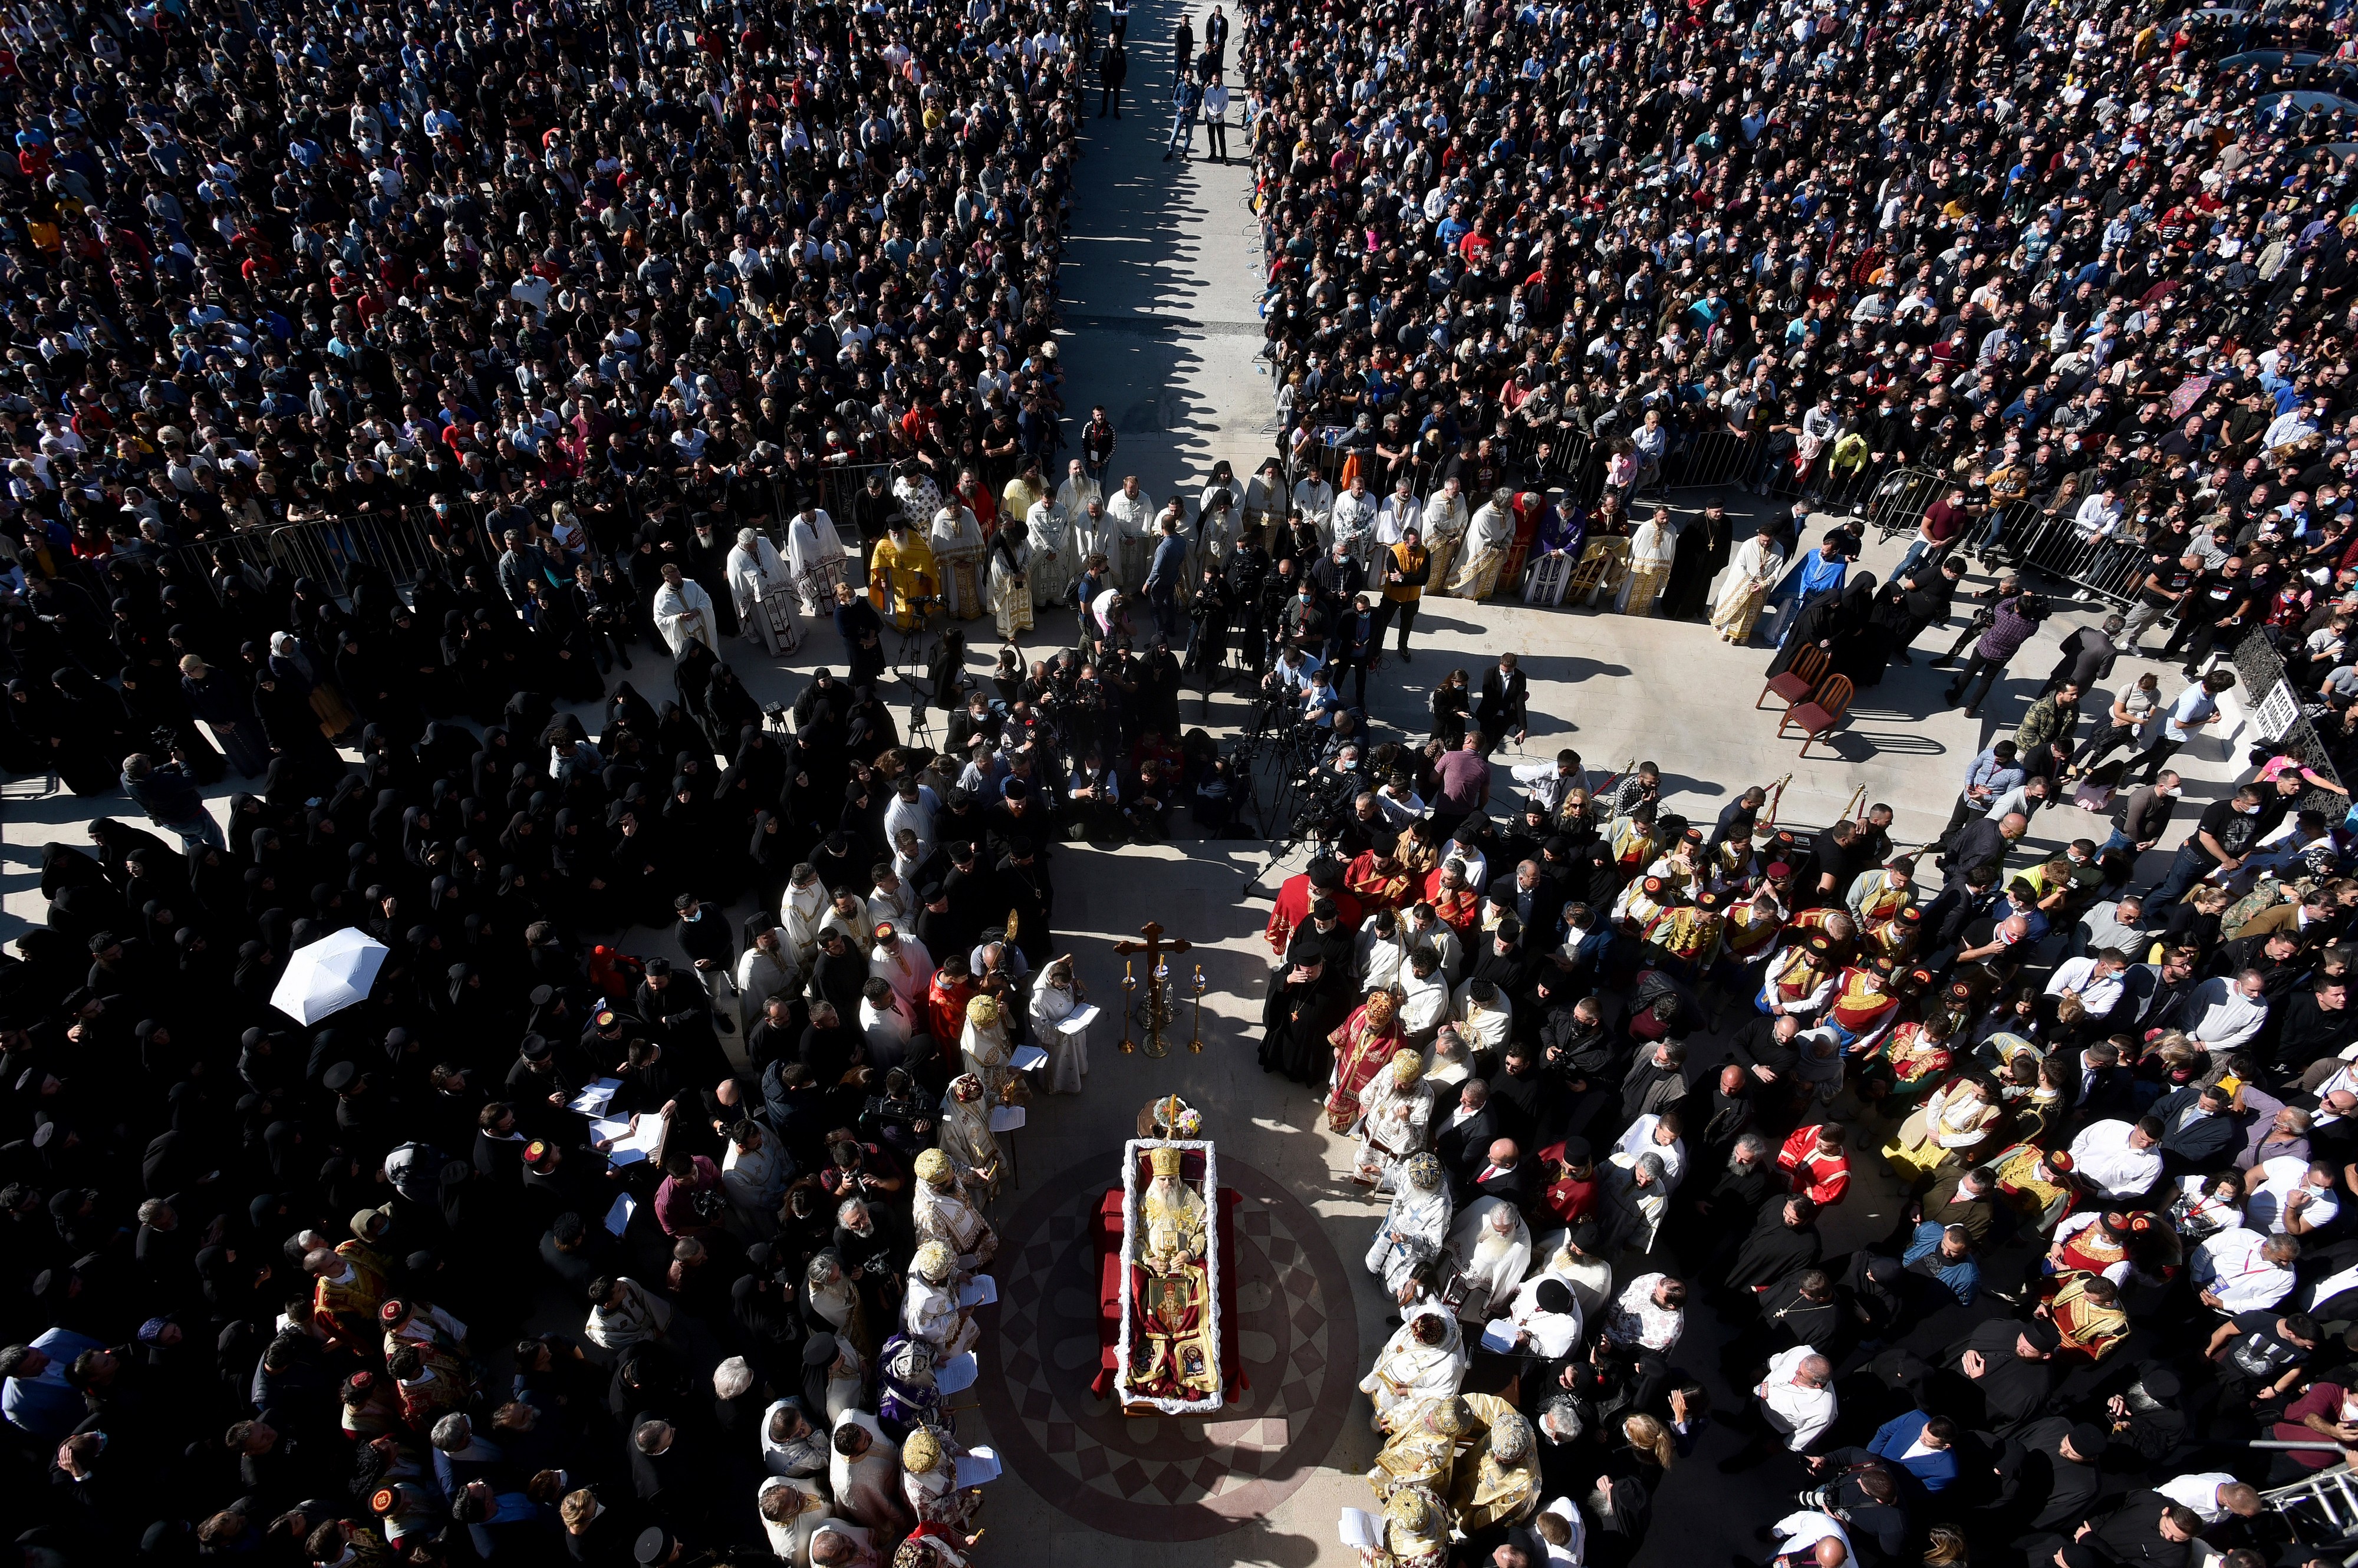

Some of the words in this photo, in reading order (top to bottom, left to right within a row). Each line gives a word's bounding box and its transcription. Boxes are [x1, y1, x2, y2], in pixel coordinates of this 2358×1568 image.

[571, 529, 581, 538] HATE
[2264, 697, 2273, 711] ЗА
[2273, 686, 2293, 722] МЈЕСТО
[2267, 704, 2285, 735] ПАЉЕЊЕ
[1386, 806, 1404, 822] СПЦ
